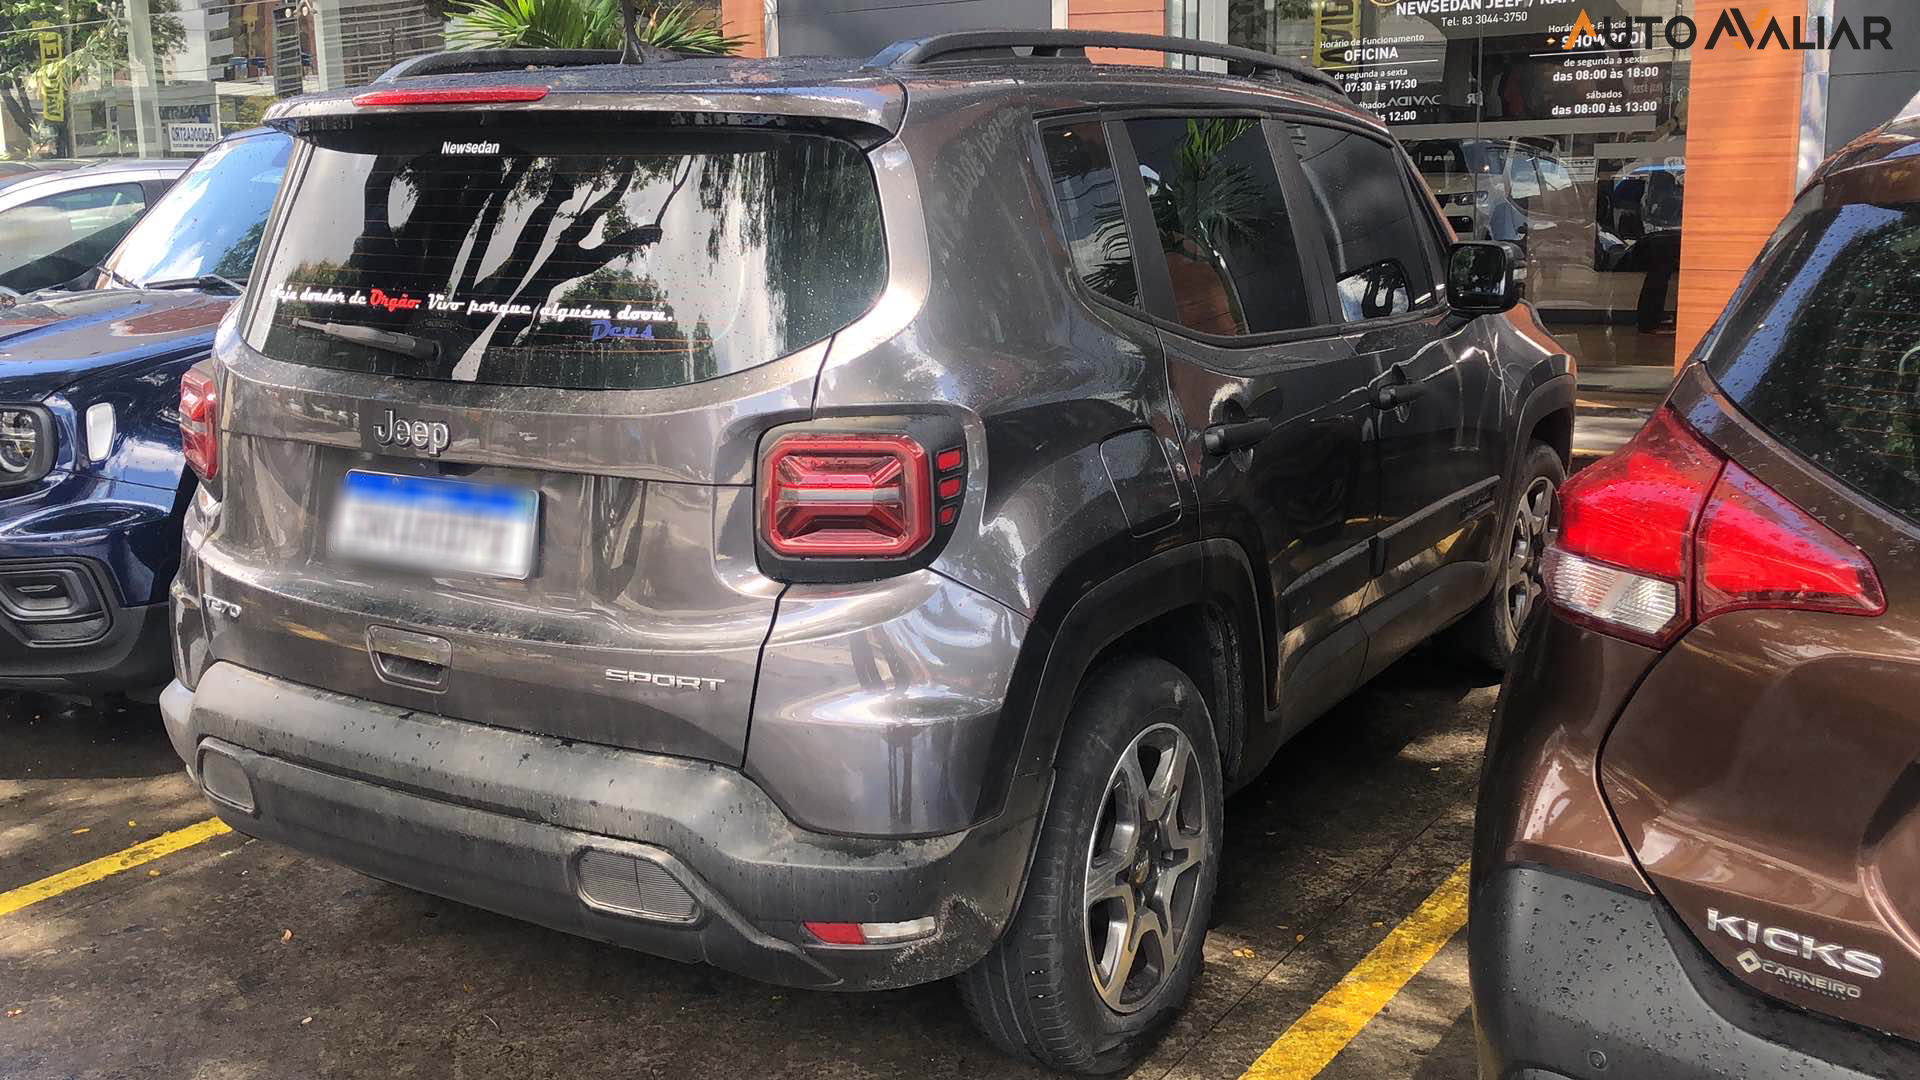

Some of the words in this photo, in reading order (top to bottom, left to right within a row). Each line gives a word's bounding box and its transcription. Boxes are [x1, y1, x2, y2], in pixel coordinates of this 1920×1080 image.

[1396, 0, 1481, 16] NEWSEDAN
[1441, 17, 1460, 27] Tel:
[1461, 15, 1473, 26] 83
[1475, 11, 1528, 25] 3044-3750
[1320, 39, 1349, 49] Horário
[1351, 38, 1361, 47] de
[1362, 34, 1425, 45] Funcionamento
[1344, 47, 1399, 62] OFICINA
[1563, 59, 1576, 67] de
[1577, 56, 1615, 69] segunda
[1624, 56, 1649, 65] sexta
[1334, 71, 1344, 80] de
[1345, 70, 1378, 81] segunda
[1386, 68, 1408, 77] sexta
[1553, 72, 1573, 82] das
[1575, 70, 1607, 80] 08:00
[1609, 68, 1624, 79] às
[1626, 66, 1659, 78] 18:00
[1344, 82, 1373, 93] 07:30
[1374, 80, 1387, 91] às
[1389, 78, 1417, 90] 17:30
[1585, 89, 1623, 99] sábados
[1388, 110, 1417, 122] 12:00
[1551, 105, 1572, 116] das
[1574, 103, 1606, 114] 08:00
[1608, 102, 1622, 113] às
[1625, 101, 1658, 112] 13:00
[441, 140, 500, 154] Newsedan
[348, 290, 367, 304] de
[427, 293, 465, 310] Vivo
[467, 300, 532, 317] porque
[539, 303, 611, 322] alguém
[592, 320, 656, 341] Deus
[373, 408, 450, 457] Jeep
[605, 668, 726, 692] SPORT
[1707, 907, 1884, 979] KICKS
[1760, 959, 1862, 999] CARNEIRO
